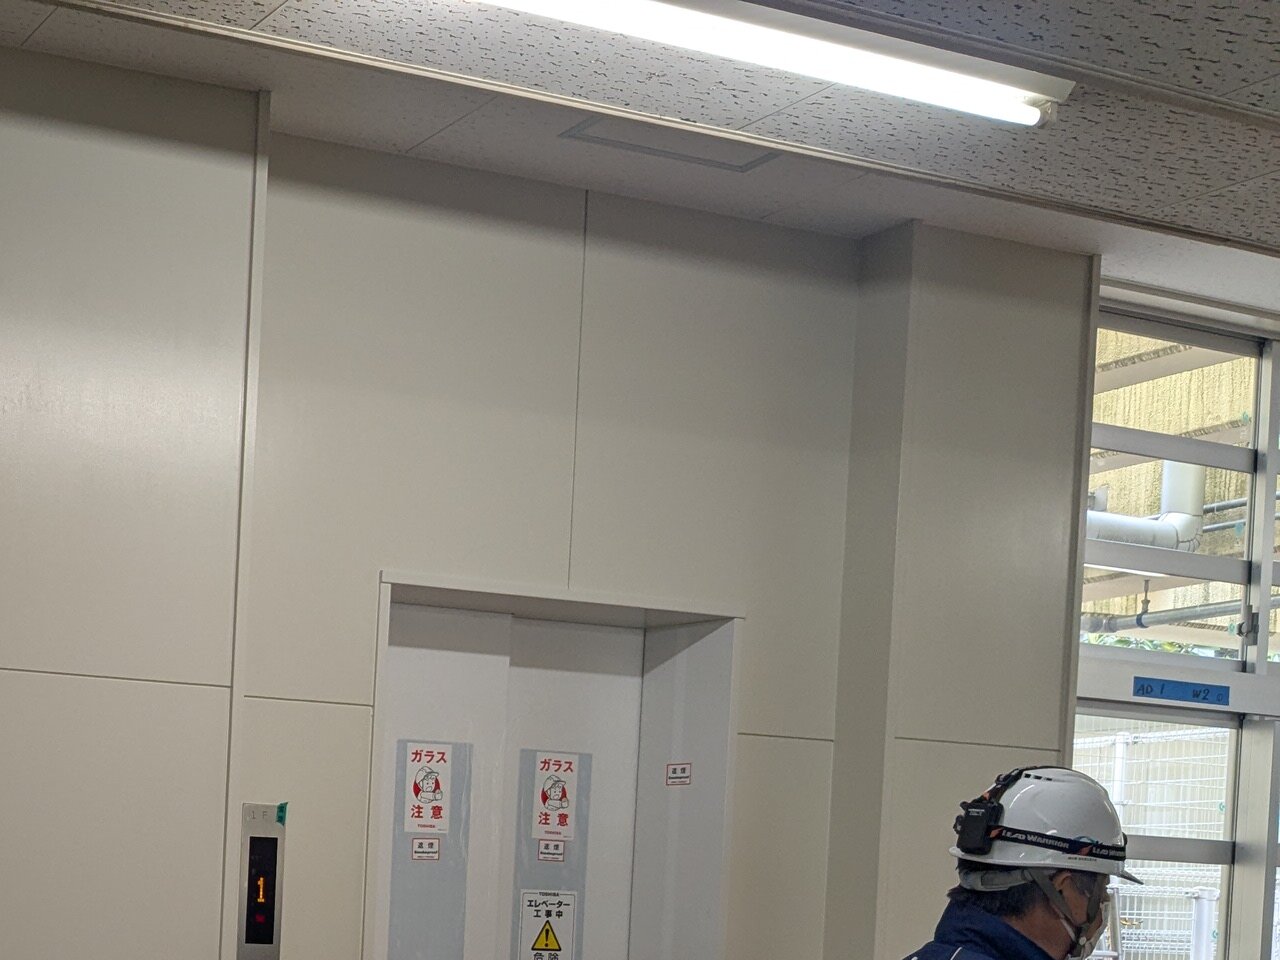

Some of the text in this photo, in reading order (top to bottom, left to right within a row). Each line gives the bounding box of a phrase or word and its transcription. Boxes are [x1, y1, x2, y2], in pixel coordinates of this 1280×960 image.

[411, 749, 448, 763] ガラス
[539, 759, 574, 772] ガラス
[257, 877, 265, 903] 1
[527, 899, 570, 909] エレベーター
[533, 909, 563, 919] 工事中
